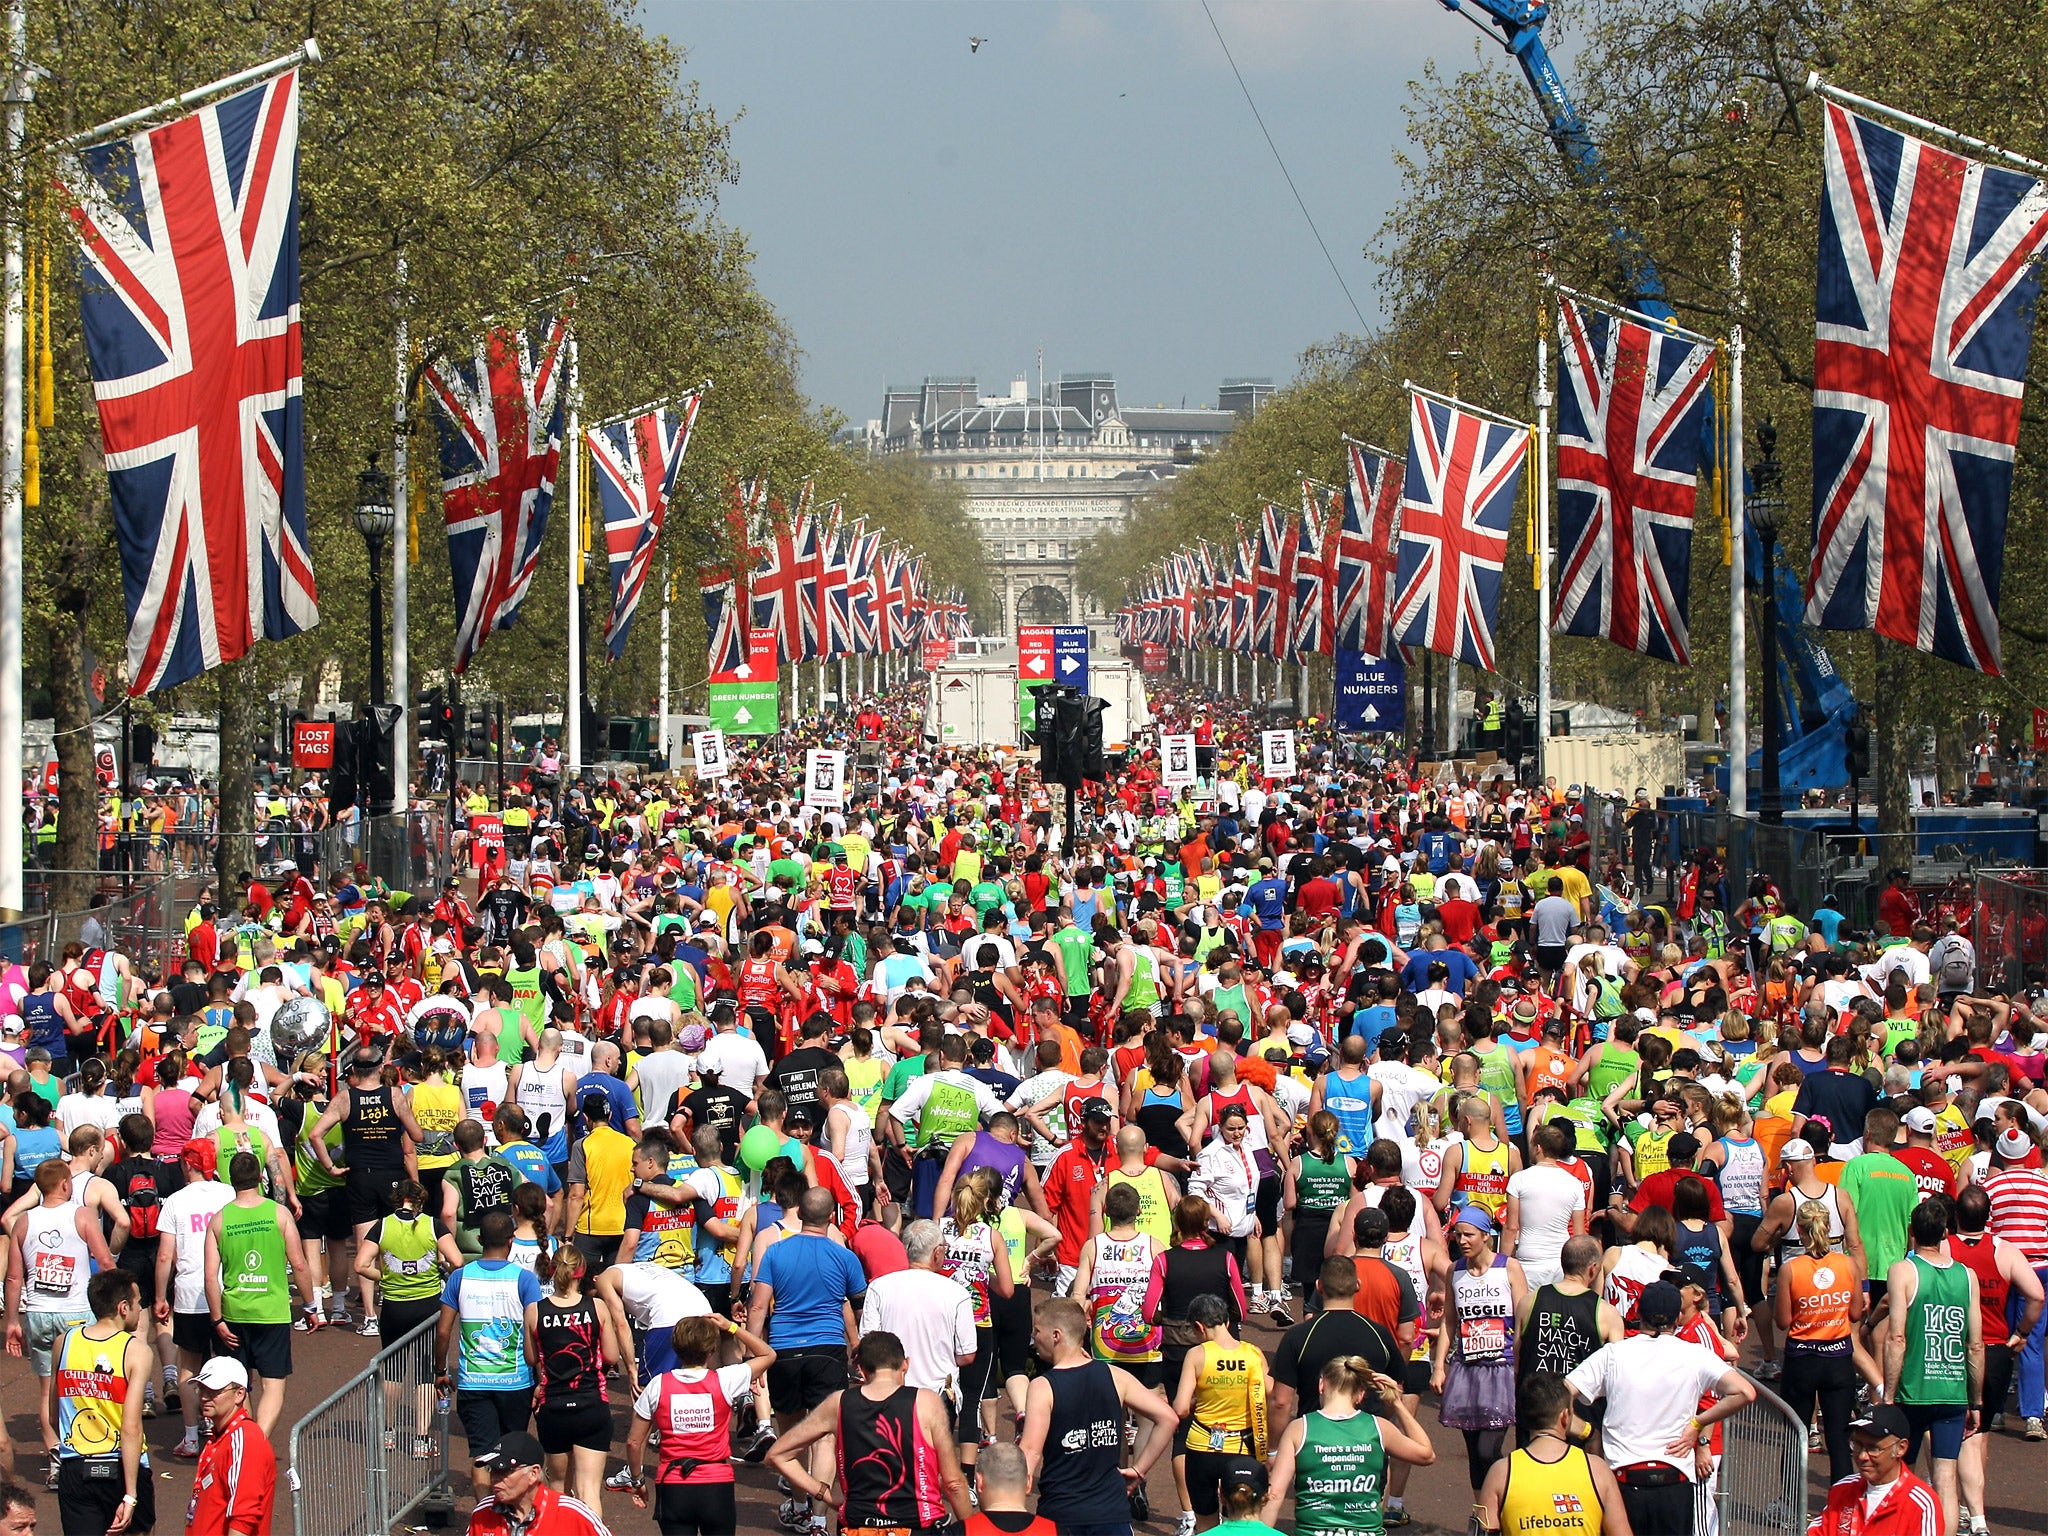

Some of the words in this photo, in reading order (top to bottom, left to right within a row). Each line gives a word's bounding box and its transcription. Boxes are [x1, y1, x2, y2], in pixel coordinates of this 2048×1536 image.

[750, 631, 775, 639] ECLAIM
[1356, 673, 1385, 682] BLUE
[1343, 685, 1398, 695] NUMBERS
[712, 693, 738, 701] GREEN
[739, 692, 776, 701] NUMBERS
[299, 730, 330, 742] LOST
[298, 743, 330, 755] TAGS
[743, 974, 772, 985] Shelter
[513, 989, 538, 999] NAY
[199, 1030, 224, 1040] MATT
[790, 1073, 804, 1082] AND
[522, 1082, 546, 1094] JDRF
[789, 1081, 818, 1092] HELENA
[359, 1095, 382, 1106] RICK
[1936, 1130, 1963, 1142] LDREN
[515, 1150, 544, 1161] MARCO
[469, 1168, 486, 1179] BE
[486, 1165, 497, 1175] A
[471, 1171, 512, 1188] MATCH,
[1465, 1173, 1505, 1183] CHILDREN
[1915, 1174, 1946, 1194] OORE
[472, 1182, 503, 1200] SAVE
[474, 1198, 486, 1210] A
[485, 1192, 510, 1208] LIFE
[226, 1219, 275, 1232] Determination
[233, 1227, 272, 1236] everything.
[36, 1269, 74, 1286] 41213
[237, 1272, 269, 1285] Oxfam
[1099, 1276, 1138, 1285] LEGENDS
[1457, 1284, 1500, 1302] Sparks
[1798, 1289, 1852, 1310] sense
[543, 1311, 593, 1328] CAZZA
[1538, 1312, 1562, 1328] BE
[1563, 1315, 1576, 1329] A
[1464, 1336, 1503, 1352] 48006
[1538, 1343, 1576, 1361] SAVE
[1216, 1359, 1246, 1372] SUE
[1206, 1374, 1235, 1387] Ability
[673, 1408, 711, 1416] Leonard
[673, 1415, 711, 1423] Cheshire
[1091, 1420, 1112, 1430] HELP
[1313, 1443, 1345, 1454] There's
[1344, 1445, 1352, 1453] a
[1352, 1443, 1373, 1453] child
[1321, 1453, 1365, 1464] depending
[1330, 1463, 1342, 1472] on
[1342, 1463, 1357, 1471] me
